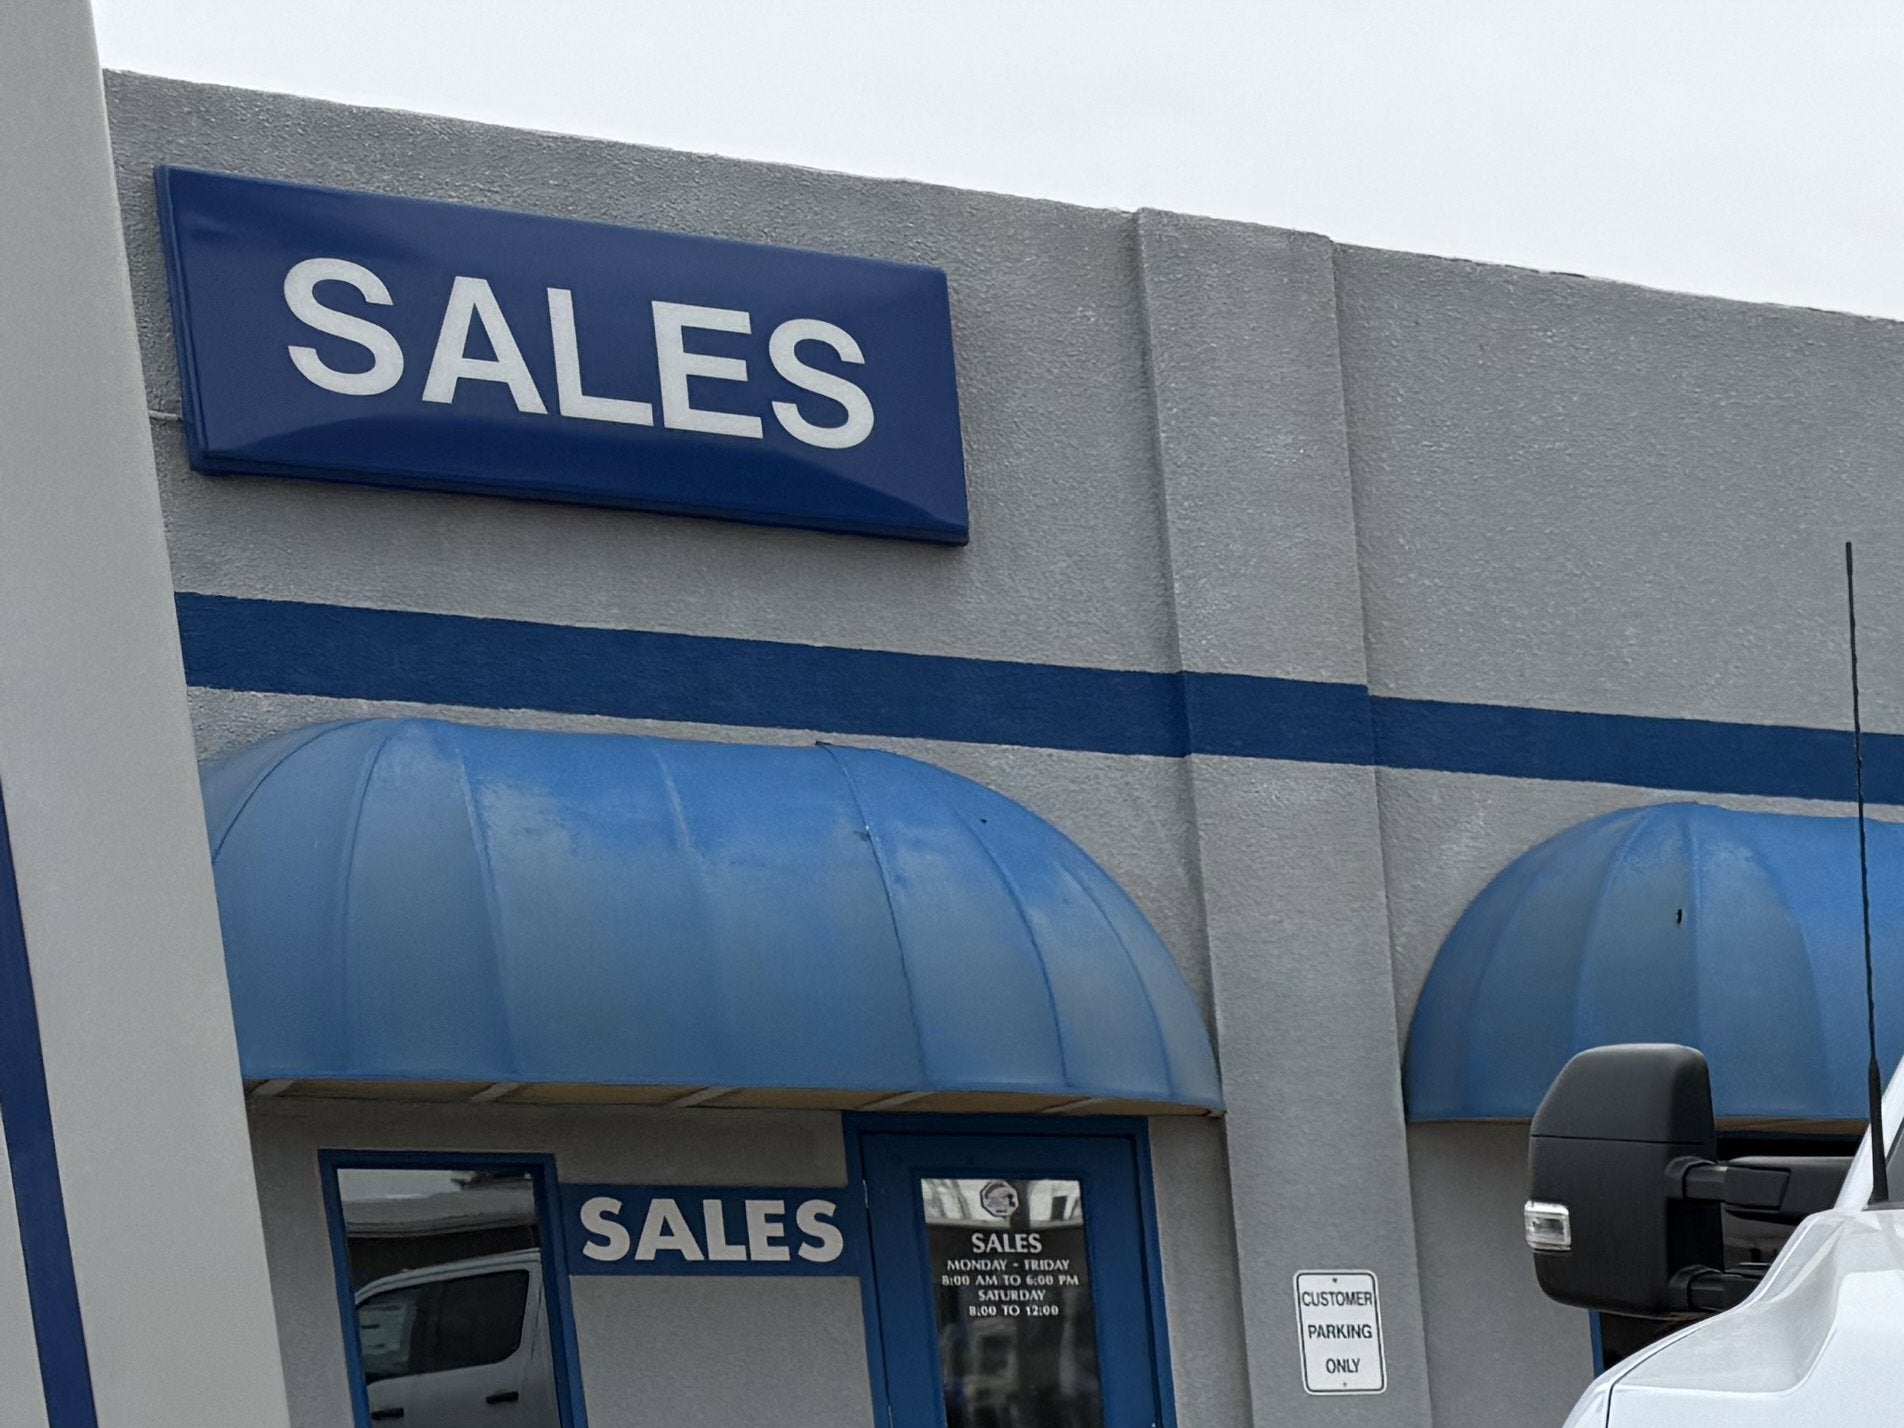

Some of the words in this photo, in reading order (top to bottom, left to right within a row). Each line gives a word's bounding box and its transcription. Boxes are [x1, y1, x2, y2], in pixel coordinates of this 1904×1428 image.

[283, 257, 876, 450] SALES
[579, 1196, 845, 1263] SALES
[971, 1233, 1042, 1253] SALES
[947, 1259, 1007, 1271] MONDAY
[1024, 1259, 1070, 1271] FRIDAY
[942, 1274, 970, 1286] 8:00
[975, 1274, 998, 1286] AM
[1002, 1274, 1021, 1286] TO
[1058, 1274, 1080, 1286] PM
[978, 1289, 1046, 1301] SATURDAY
[1302, 1291, 1373, 1306] CUSTOMER
[969, 1305, 997, 1317] 8:00
[1002, 1305, 1021, 1317] TO
[1025, 1305, 1059, 1316] 12:00
[1308, 1324, 1373, 1339] PARKING
[1325, 1358, 1360, 1374] ONLY
